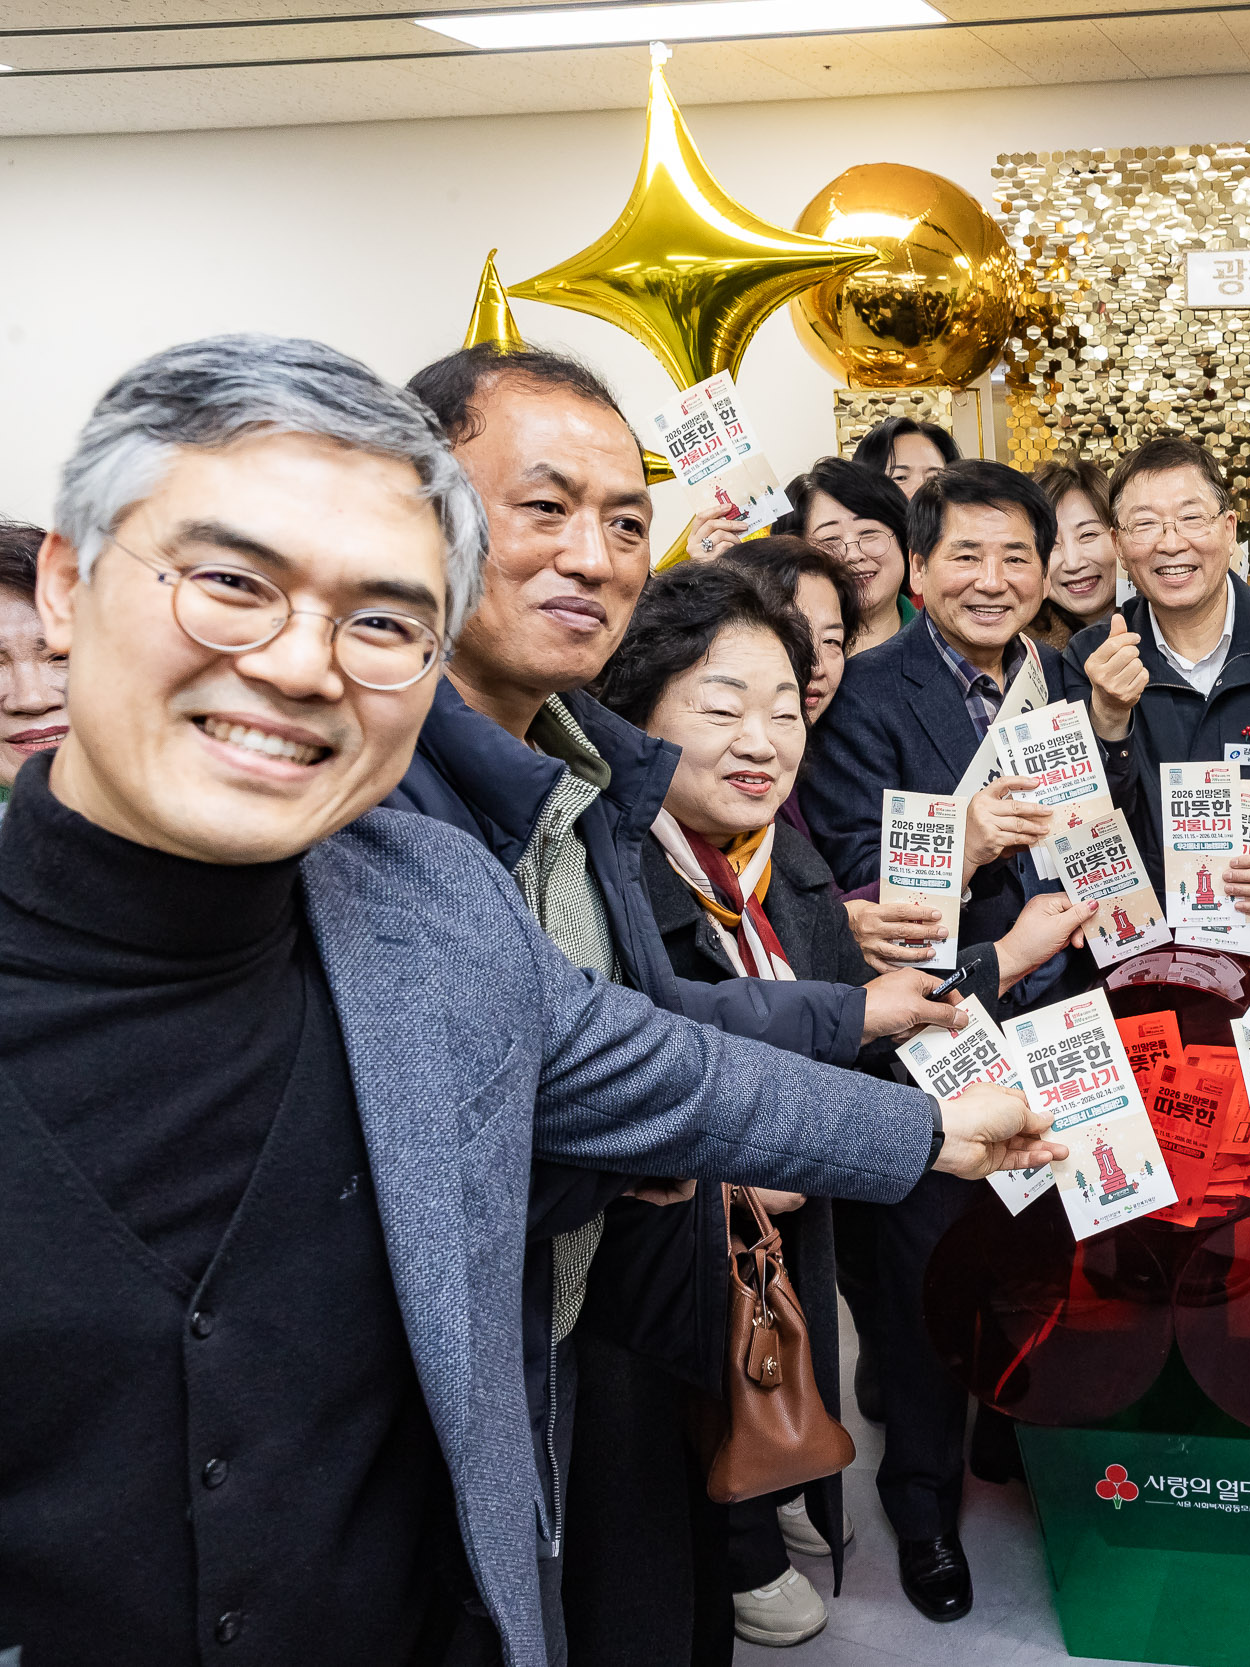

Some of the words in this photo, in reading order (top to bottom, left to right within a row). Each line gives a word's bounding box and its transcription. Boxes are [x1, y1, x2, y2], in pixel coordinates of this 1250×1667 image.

[665, 427, 682, 443] 2026
[668, 420, 717, 458] 따뜻한
[1022, 742, 1046, 756] 2026
[1047, 730, 1083, 749] 희망온돌
[1025, 741, 1088, 775] 따뜻한
[1171, 790, 1193, 799] 2026
[1195, 789, 1230, 799] 희망온돌
[1171, 799, 1232, 818] 따뜻한
[892, 819, 914, 831] 2026
[916, 822, 954, 834] 희망온돌
[1172, 818, 1231, 832] 겨울나기
[889, 831, 954, 854] 따뜻한
[1063, 849, 1086, 864] 2026
[1086, 834, 1122, 854] 희망온돌
[889, 850, 952, 869] 겨울나기
[1066, 843, 1128, 879] 따뜻한
[1073, 858, 1132, 890] 겨울나기
[925, 1056, 951, 1078] 2026
[949, 1028, 988, 1061] 희망온돌
[1027, 1045, 1057, 1064] 2026
[1058, 1026, 1105, 1053] 희망온돌
[932, 1039, 1001, 1098] 따뜻한
[1030, 1041, 1113, 1088] 따뜻한
[1039, 1065, 1120, 1107] 겨울나기
[1159, 1085, 1182, 1099] 2026
[1153, 1094, 1217, 1128] 따뜻한
